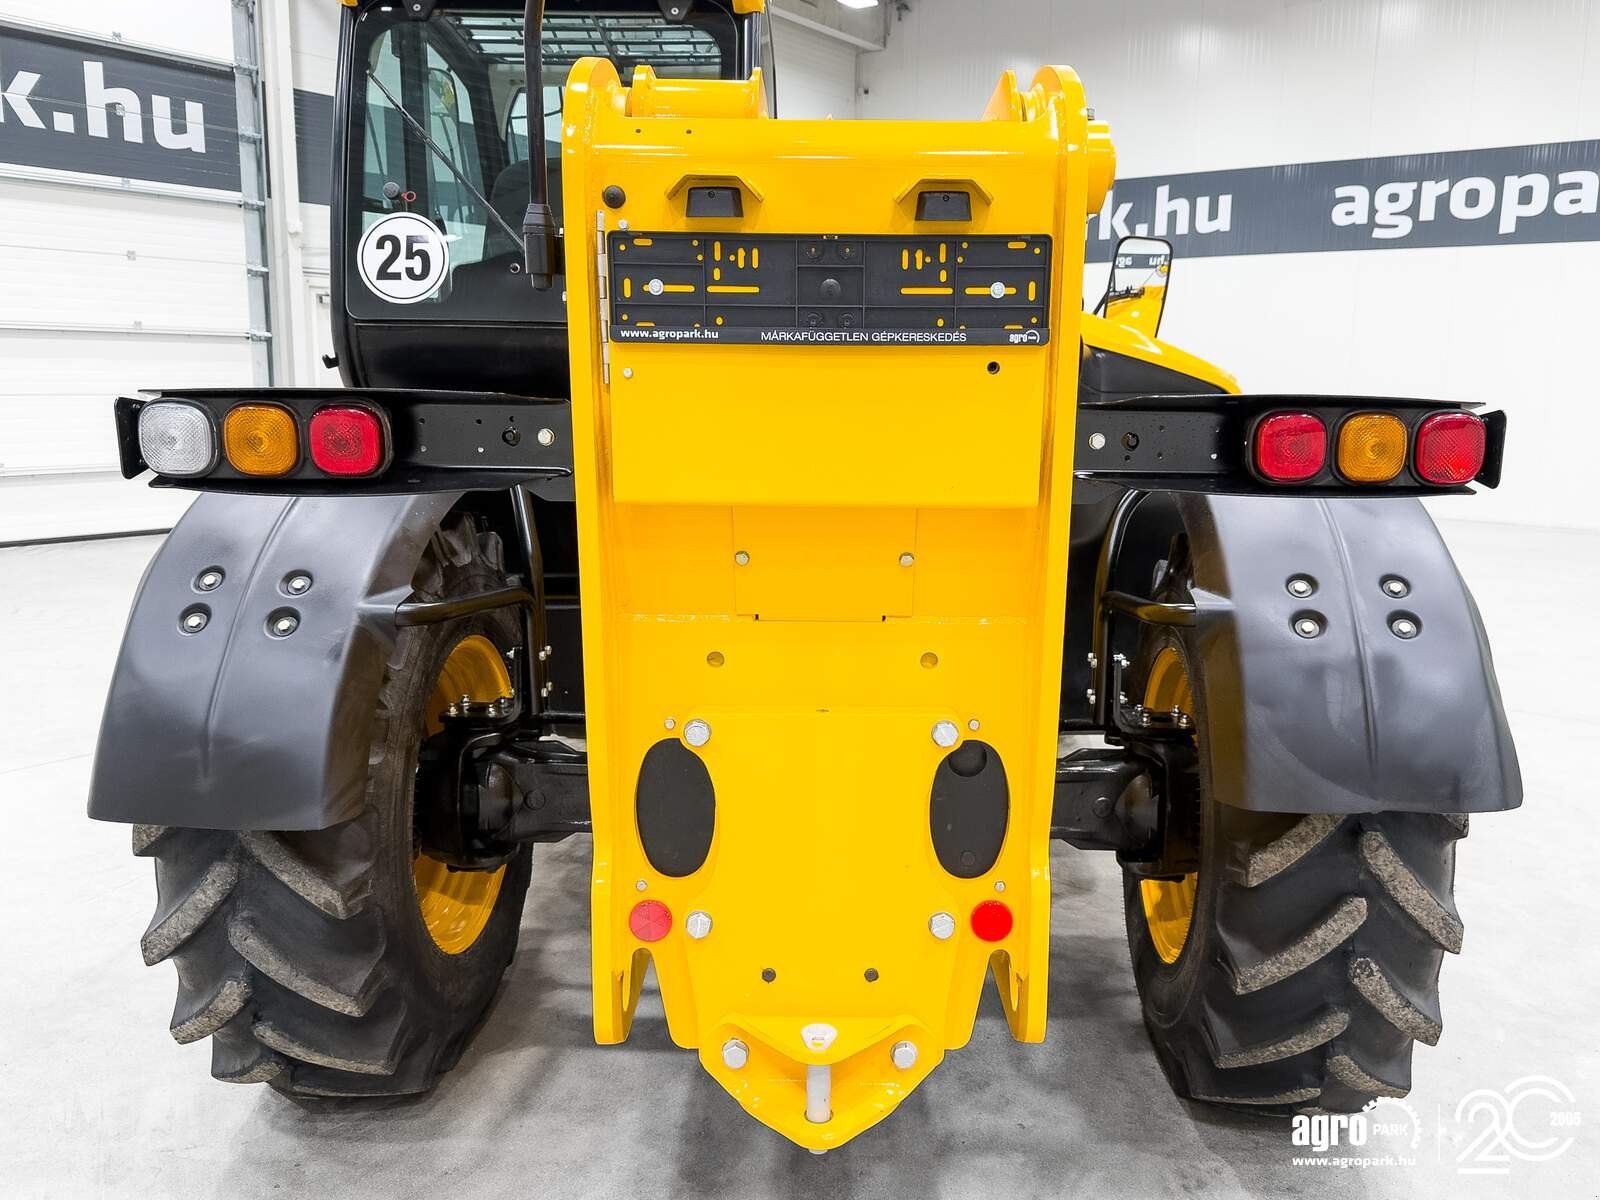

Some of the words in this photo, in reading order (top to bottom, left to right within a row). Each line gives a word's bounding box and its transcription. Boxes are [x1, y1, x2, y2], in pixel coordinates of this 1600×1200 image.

[1331, 170, 1600, 239] agropa
[375, 234, 431, 281] 25
[620, 328, 719, 340] www.agropark.hu
[761, 330, 869, 342] MÁRKAFÜGGETLEN
[873, 330, 967, 342] GÉPKERESKEDÉS
[1008, 333, 1028, 344] agro
